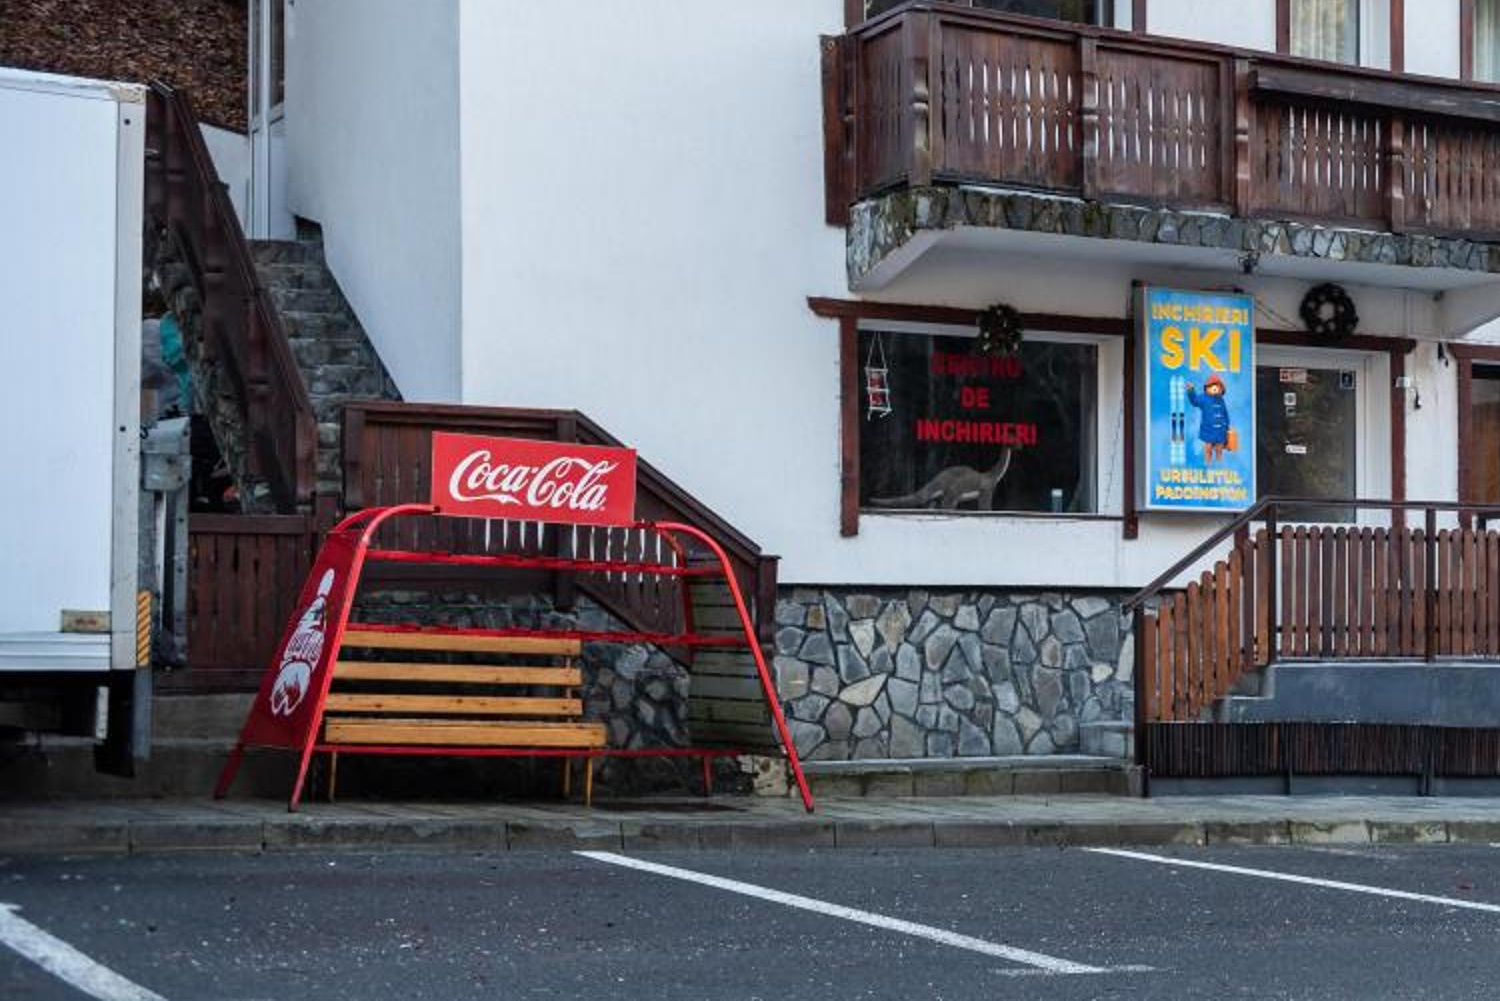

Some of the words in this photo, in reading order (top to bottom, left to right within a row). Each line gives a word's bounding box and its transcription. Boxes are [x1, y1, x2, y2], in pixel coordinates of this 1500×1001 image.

[1159, 326, 1242, 373] SKI
[960, 385, 991, 408] DE
[916, 418, 1037, 445] INCHIRIERI
[448, 450, 619, 511] Coca-Cola
